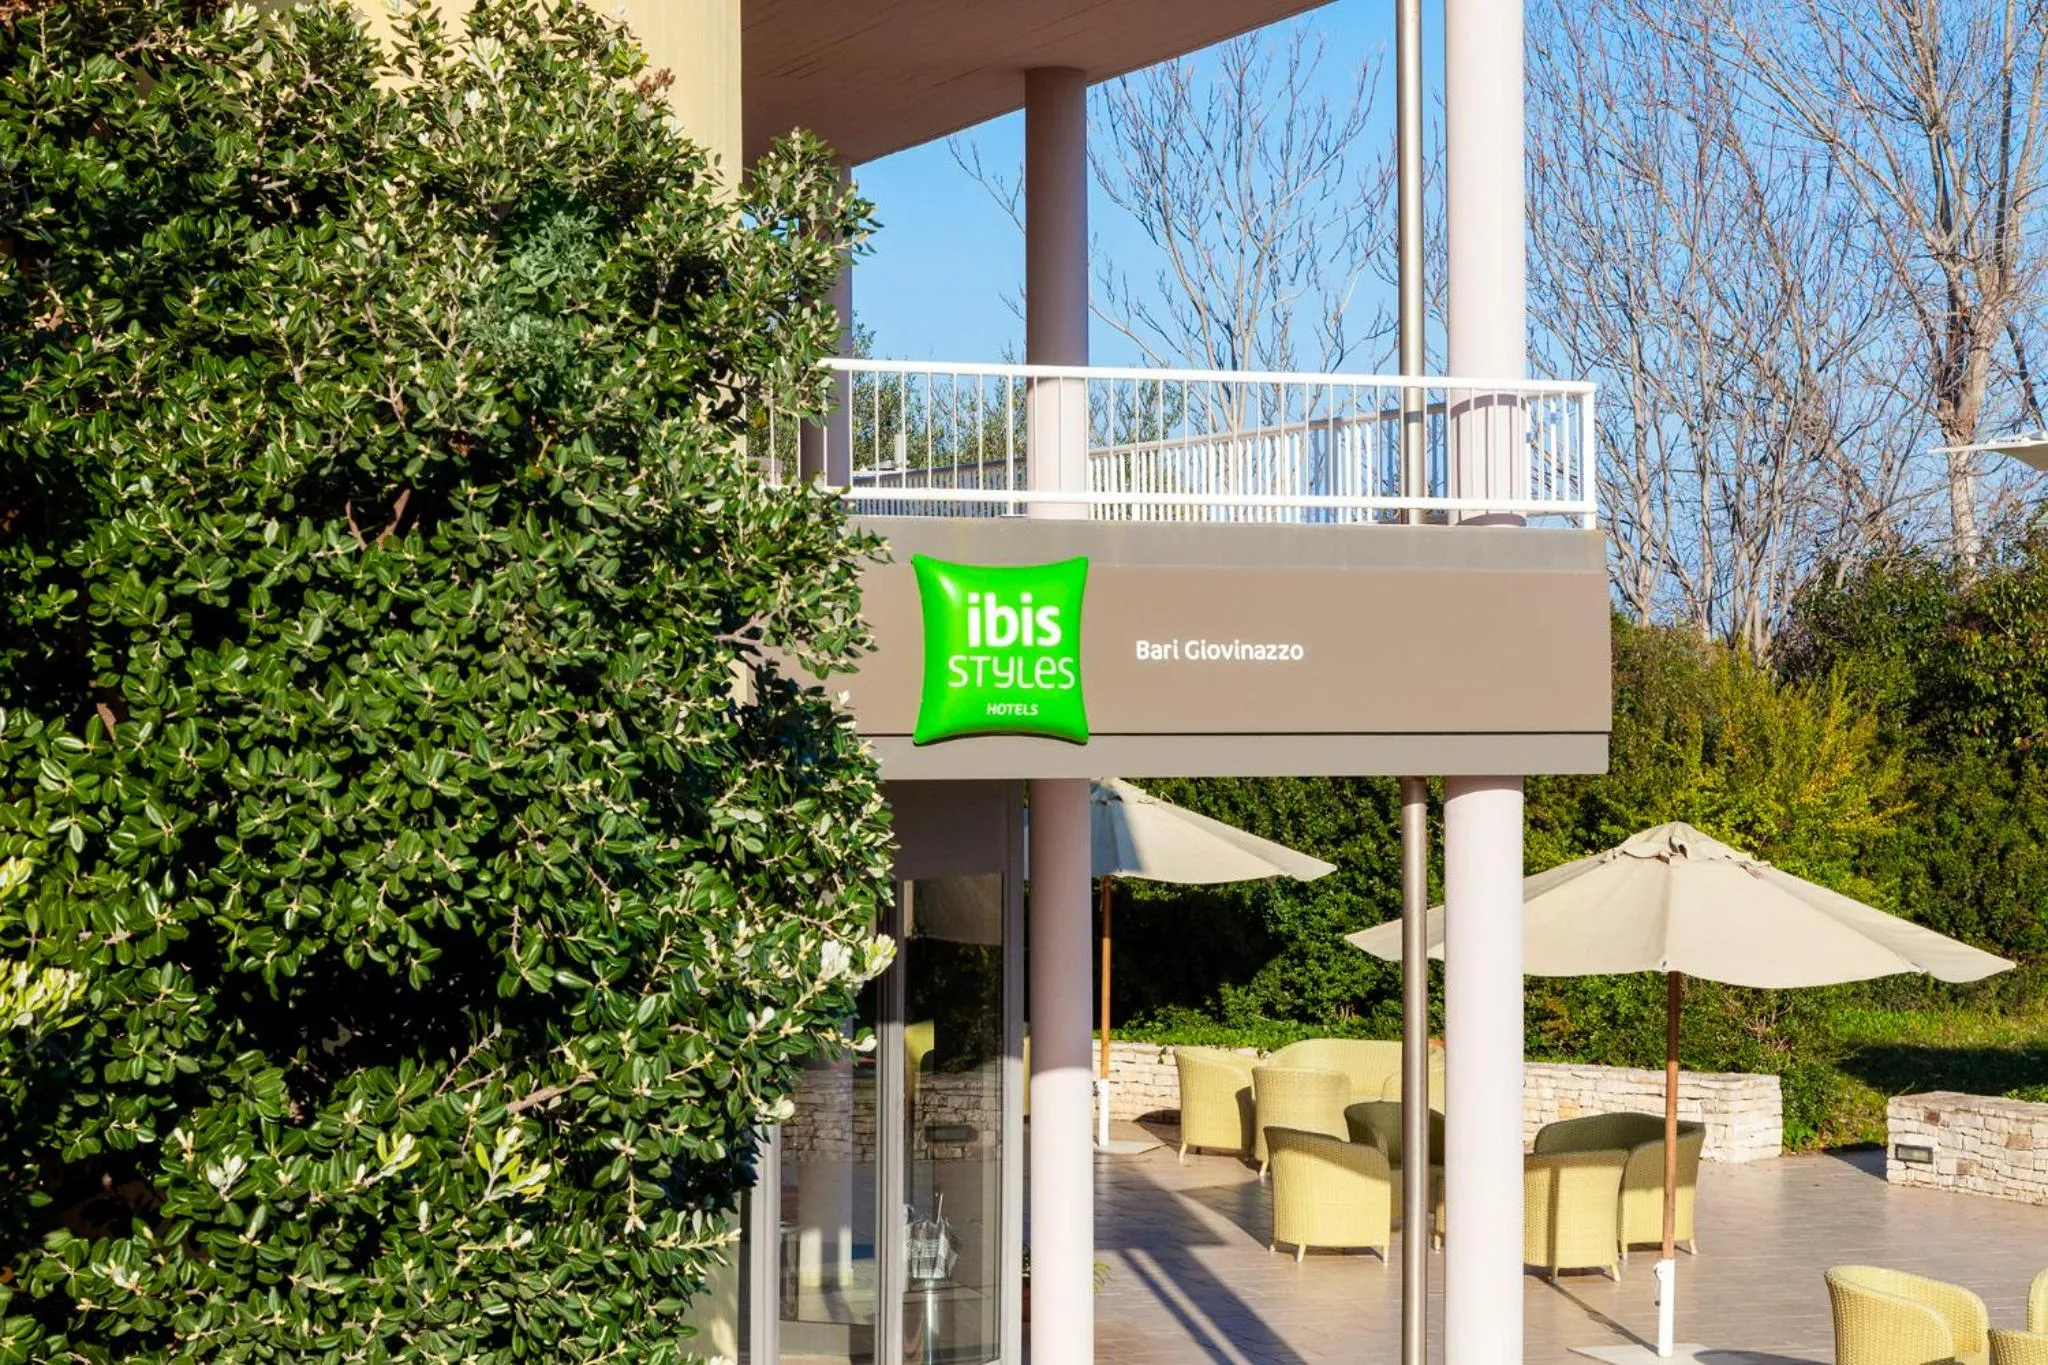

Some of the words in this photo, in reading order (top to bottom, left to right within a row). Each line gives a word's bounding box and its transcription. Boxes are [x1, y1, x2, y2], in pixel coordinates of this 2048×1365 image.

[967, 592, 1062, 648] ibis
[1135, 639, 1179, 661] Bari
[1184, 639, 1305, 661] Giovinazzo
[987, 703, 1039, 717] HOTELS
